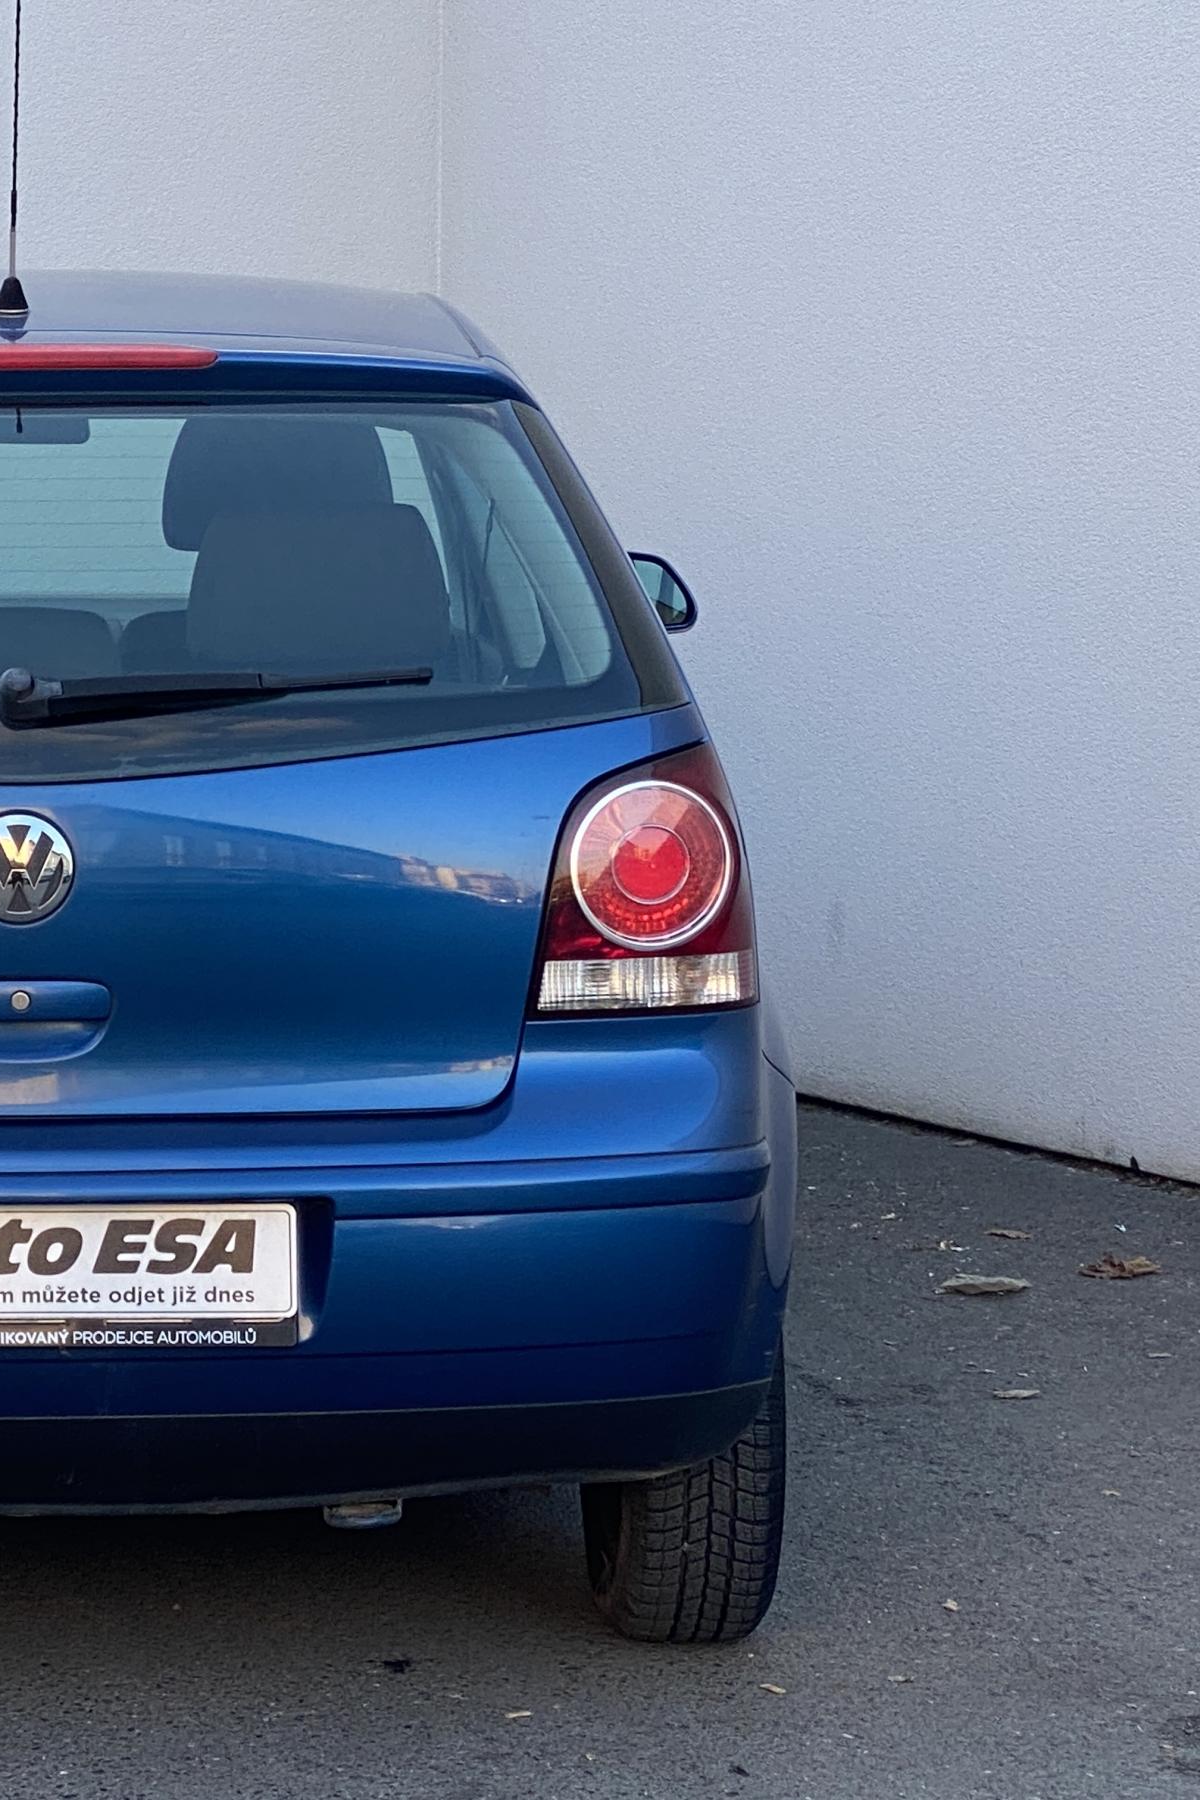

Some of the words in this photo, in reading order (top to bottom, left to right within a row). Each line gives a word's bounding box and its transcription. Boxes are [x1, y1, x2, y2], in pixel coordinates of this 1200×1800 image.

[92, 1218, 256, 1275] ESA
[22, 1284, 101, 1303] můžete
[108, 1286, 165, 1306] odjet
[171, 1286, 197, 1306] již
[204, 1286, 255, 1303] dnes
[73, 1331, 153, 1345] PRODEJCE
[157, 1327, 256, 1345] AUTOMOBILŮ
